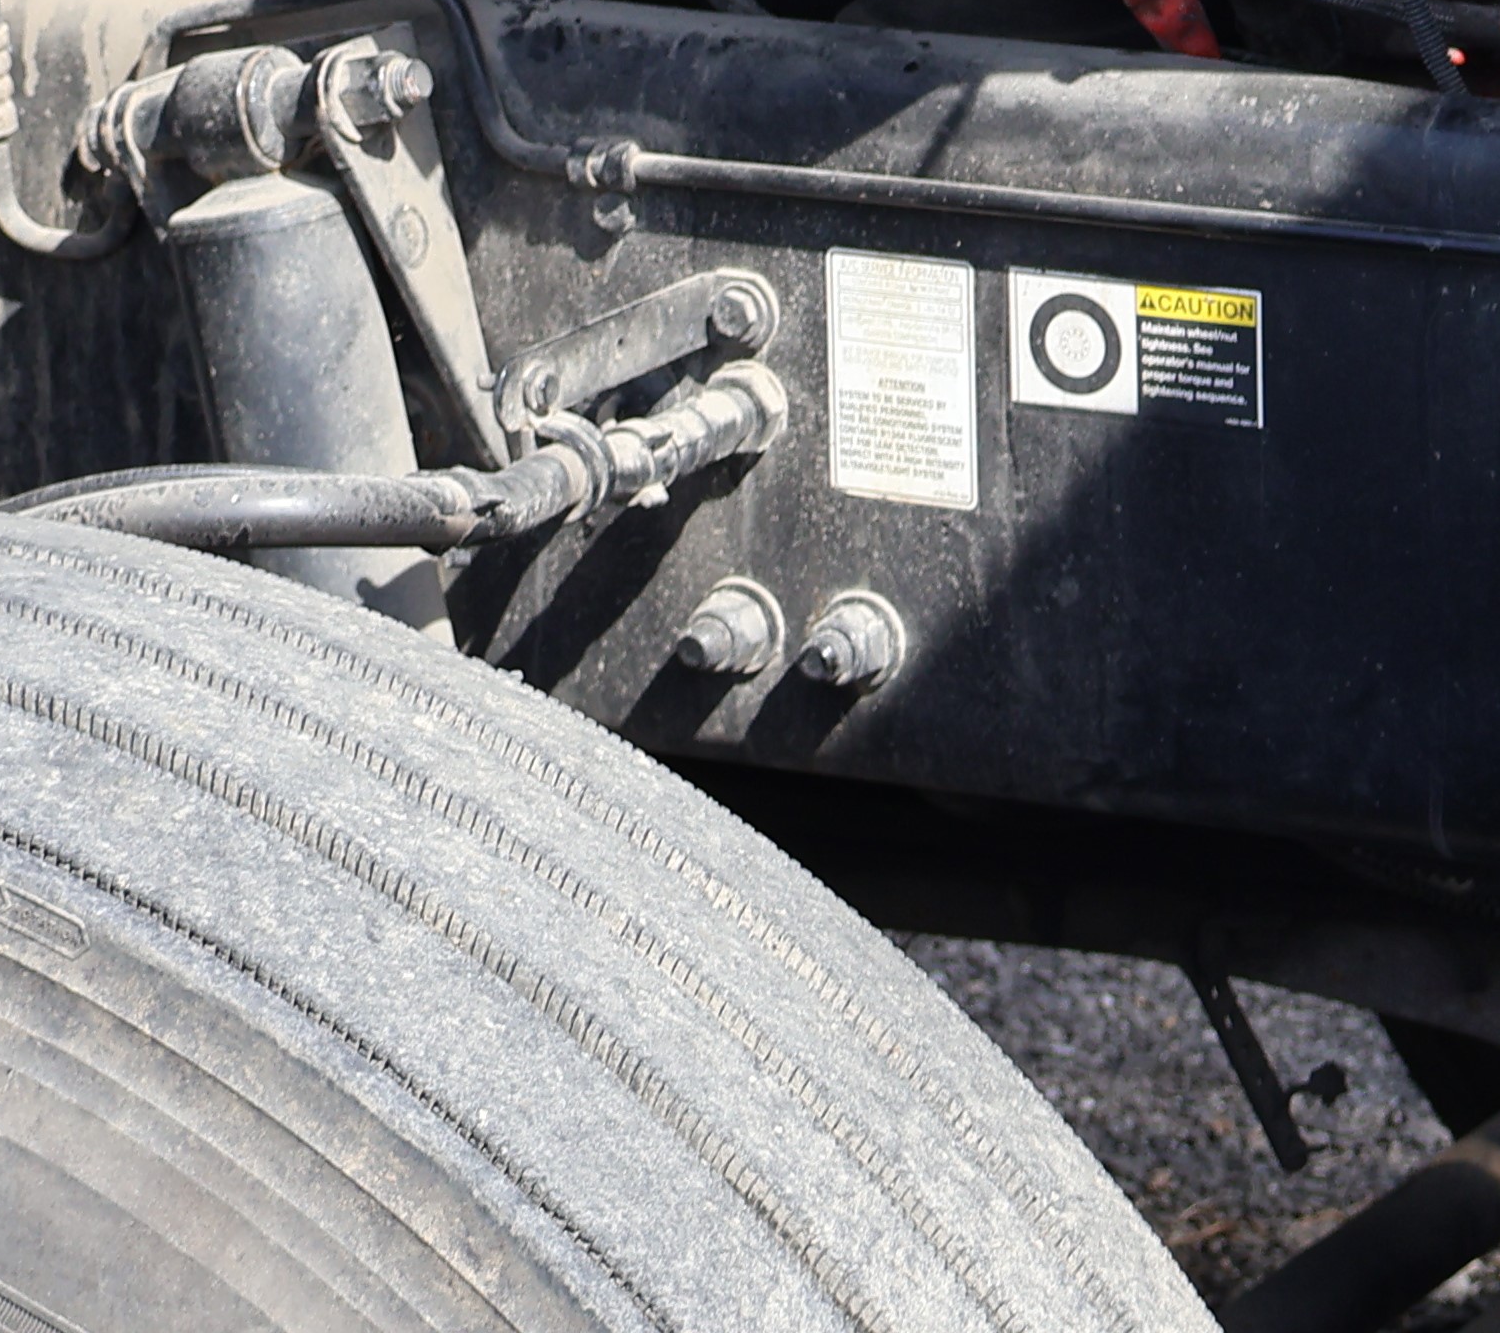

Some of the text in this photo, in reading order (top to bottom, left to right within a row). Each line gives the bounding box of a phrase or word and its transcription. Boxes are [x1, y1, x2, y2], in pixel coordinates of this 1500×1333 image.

[1158, 293, 1253, 321] CAUTION
[1141, 321, 1238, 343] Maintain wheel/nut
[1141, 338, 1213, 356] tightness. See
[1141, 354, 1251, 375] operator's manual for
[878, 377, 926, 393] ATTENTION
[1141, 370, 1234, 389] proper torque and
[839, 389, 869, 400] SYSTEM
[884, 393, 893, 403] BE
[936, 400, 946, 411] BY
[1142, 383, 1247, 405] tightening sequence.
